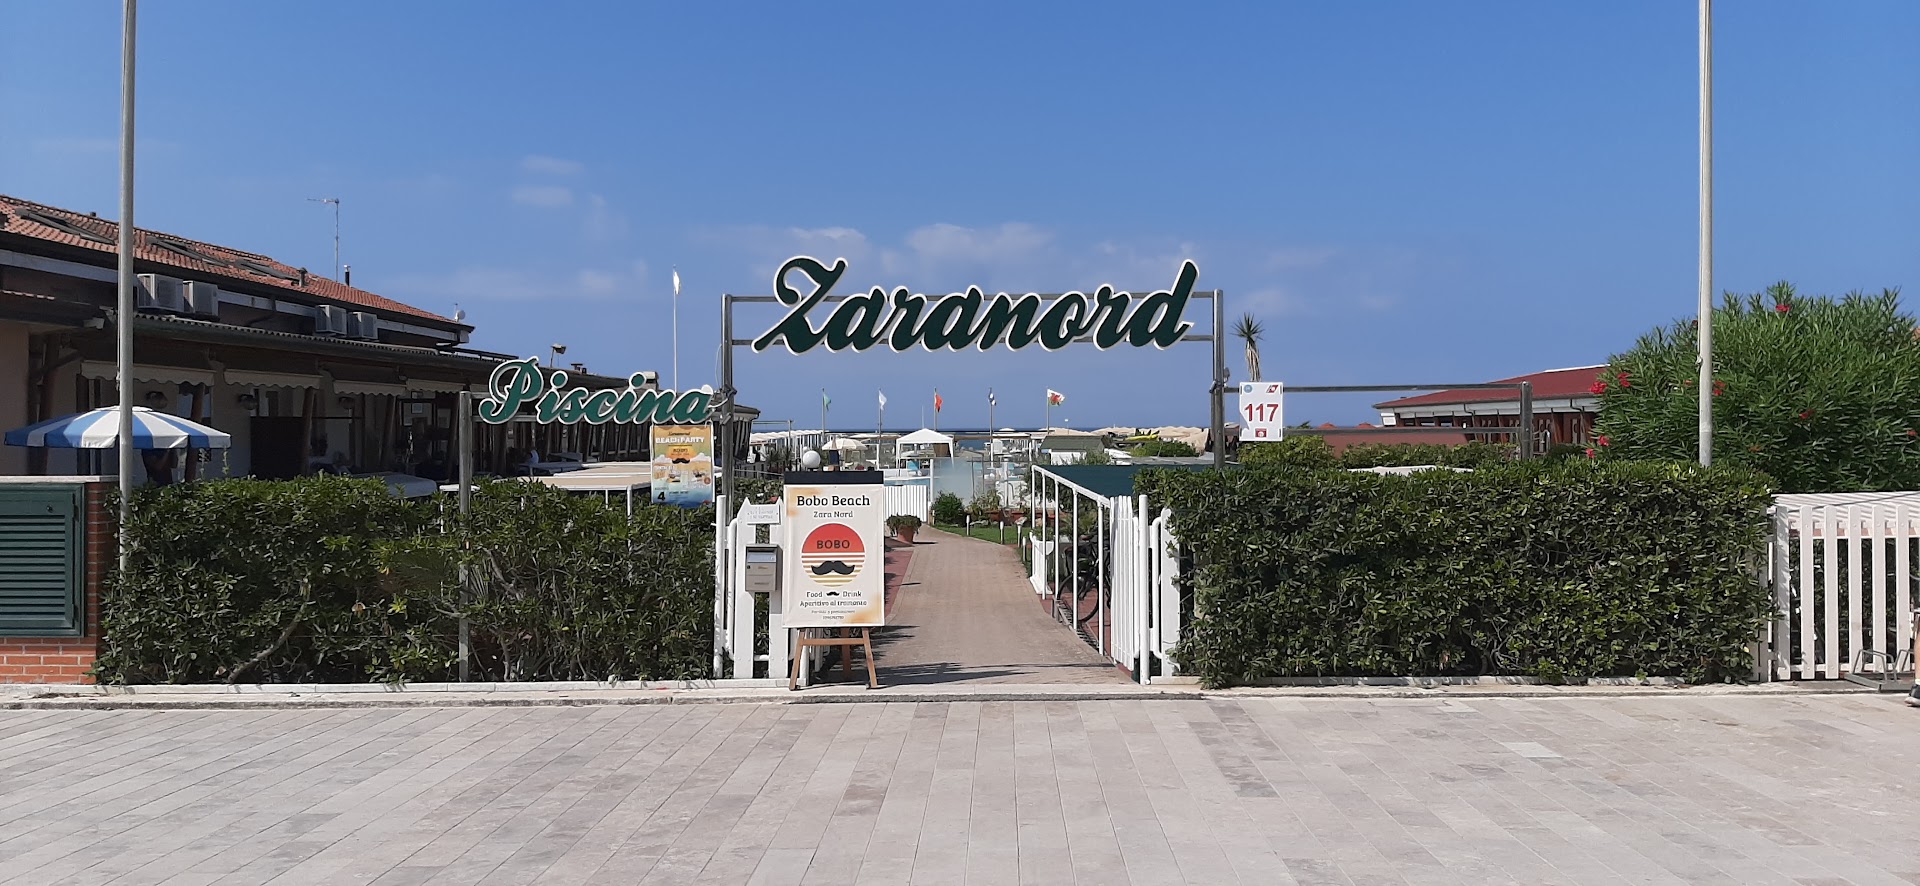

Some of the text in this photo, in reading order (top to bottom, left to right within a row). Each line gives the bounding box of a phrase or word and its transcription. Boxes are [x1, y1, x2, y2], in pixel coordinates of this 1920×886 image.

[751, 255, 1199, 355] Zaranord
[479, 356, 713, 426] Piscina
[1244, 403, 1279, 422] 117
[657, 491, 666, 500] 4
[797, 495, 870, 506] Bobo Beach
[816, 539, 850, 549] BOBO
